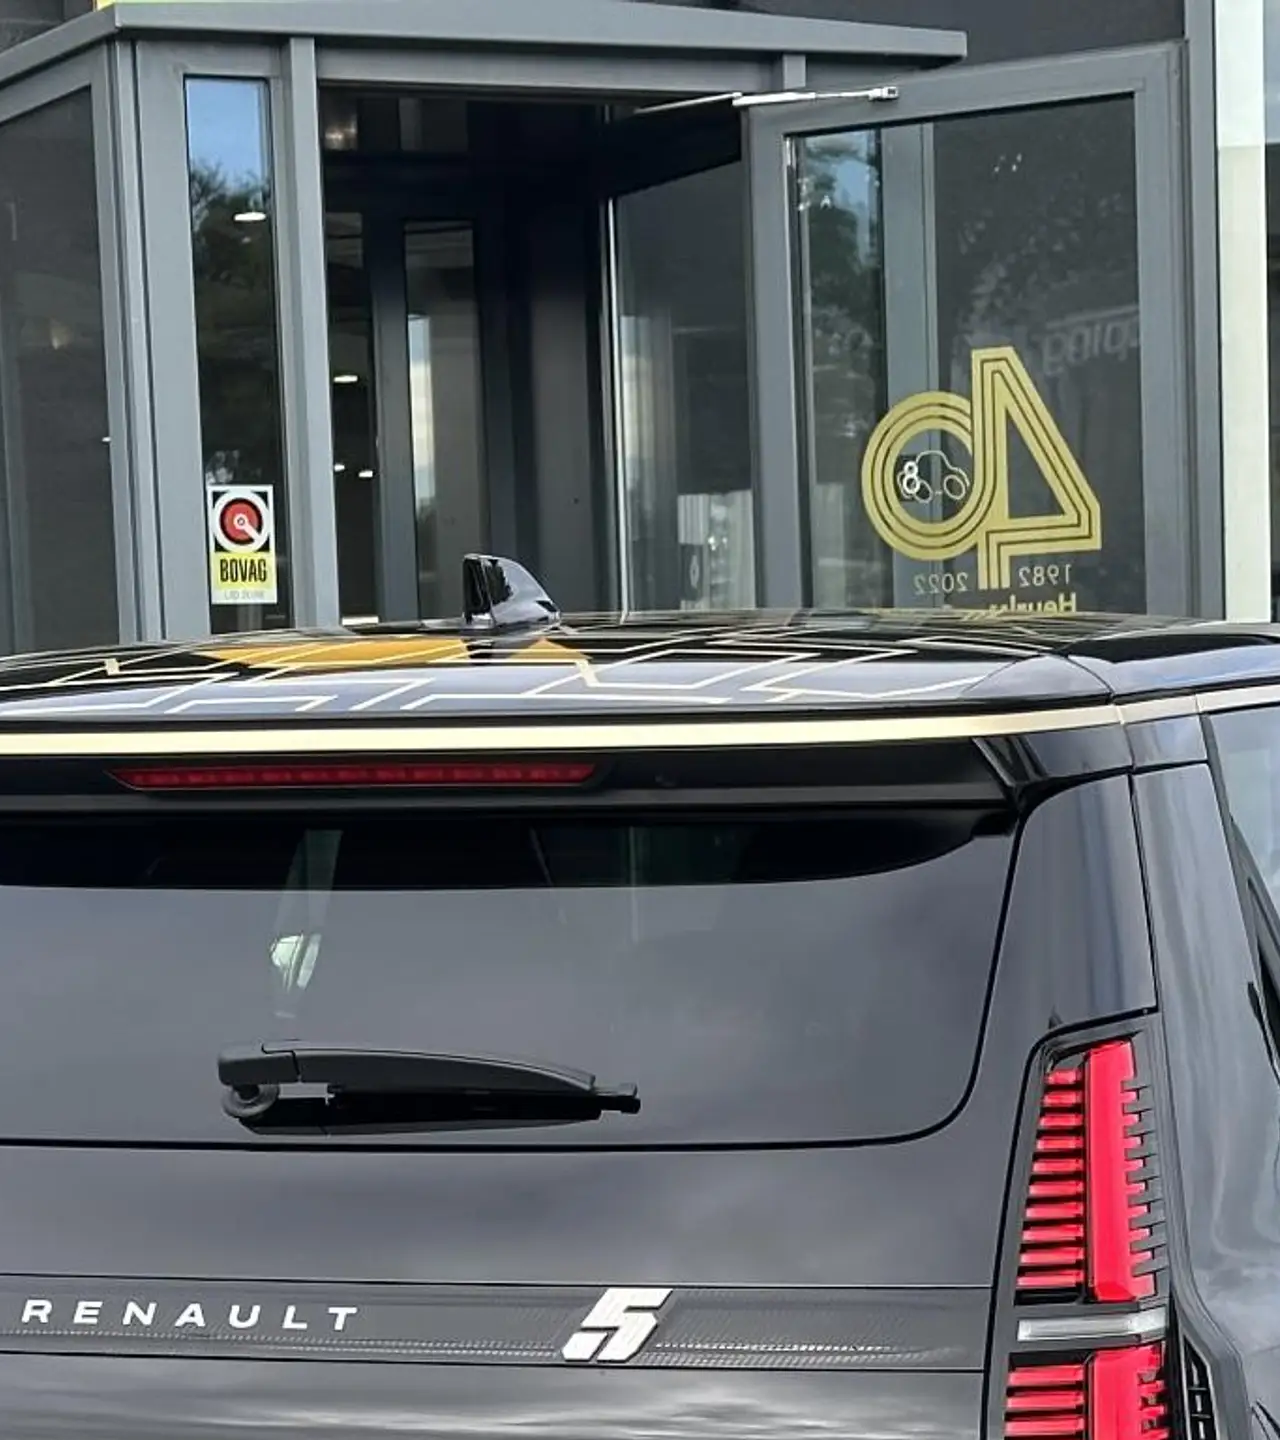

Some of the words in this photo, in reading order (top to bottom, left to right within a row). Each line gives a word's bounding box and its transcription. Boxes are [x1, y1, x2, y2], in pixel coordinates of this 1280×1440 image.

[220, 558, 267, 582] BOVAG
[20, 1299, 358, 1332] RENAULT
[561, 1286, 673, 1364] 5
